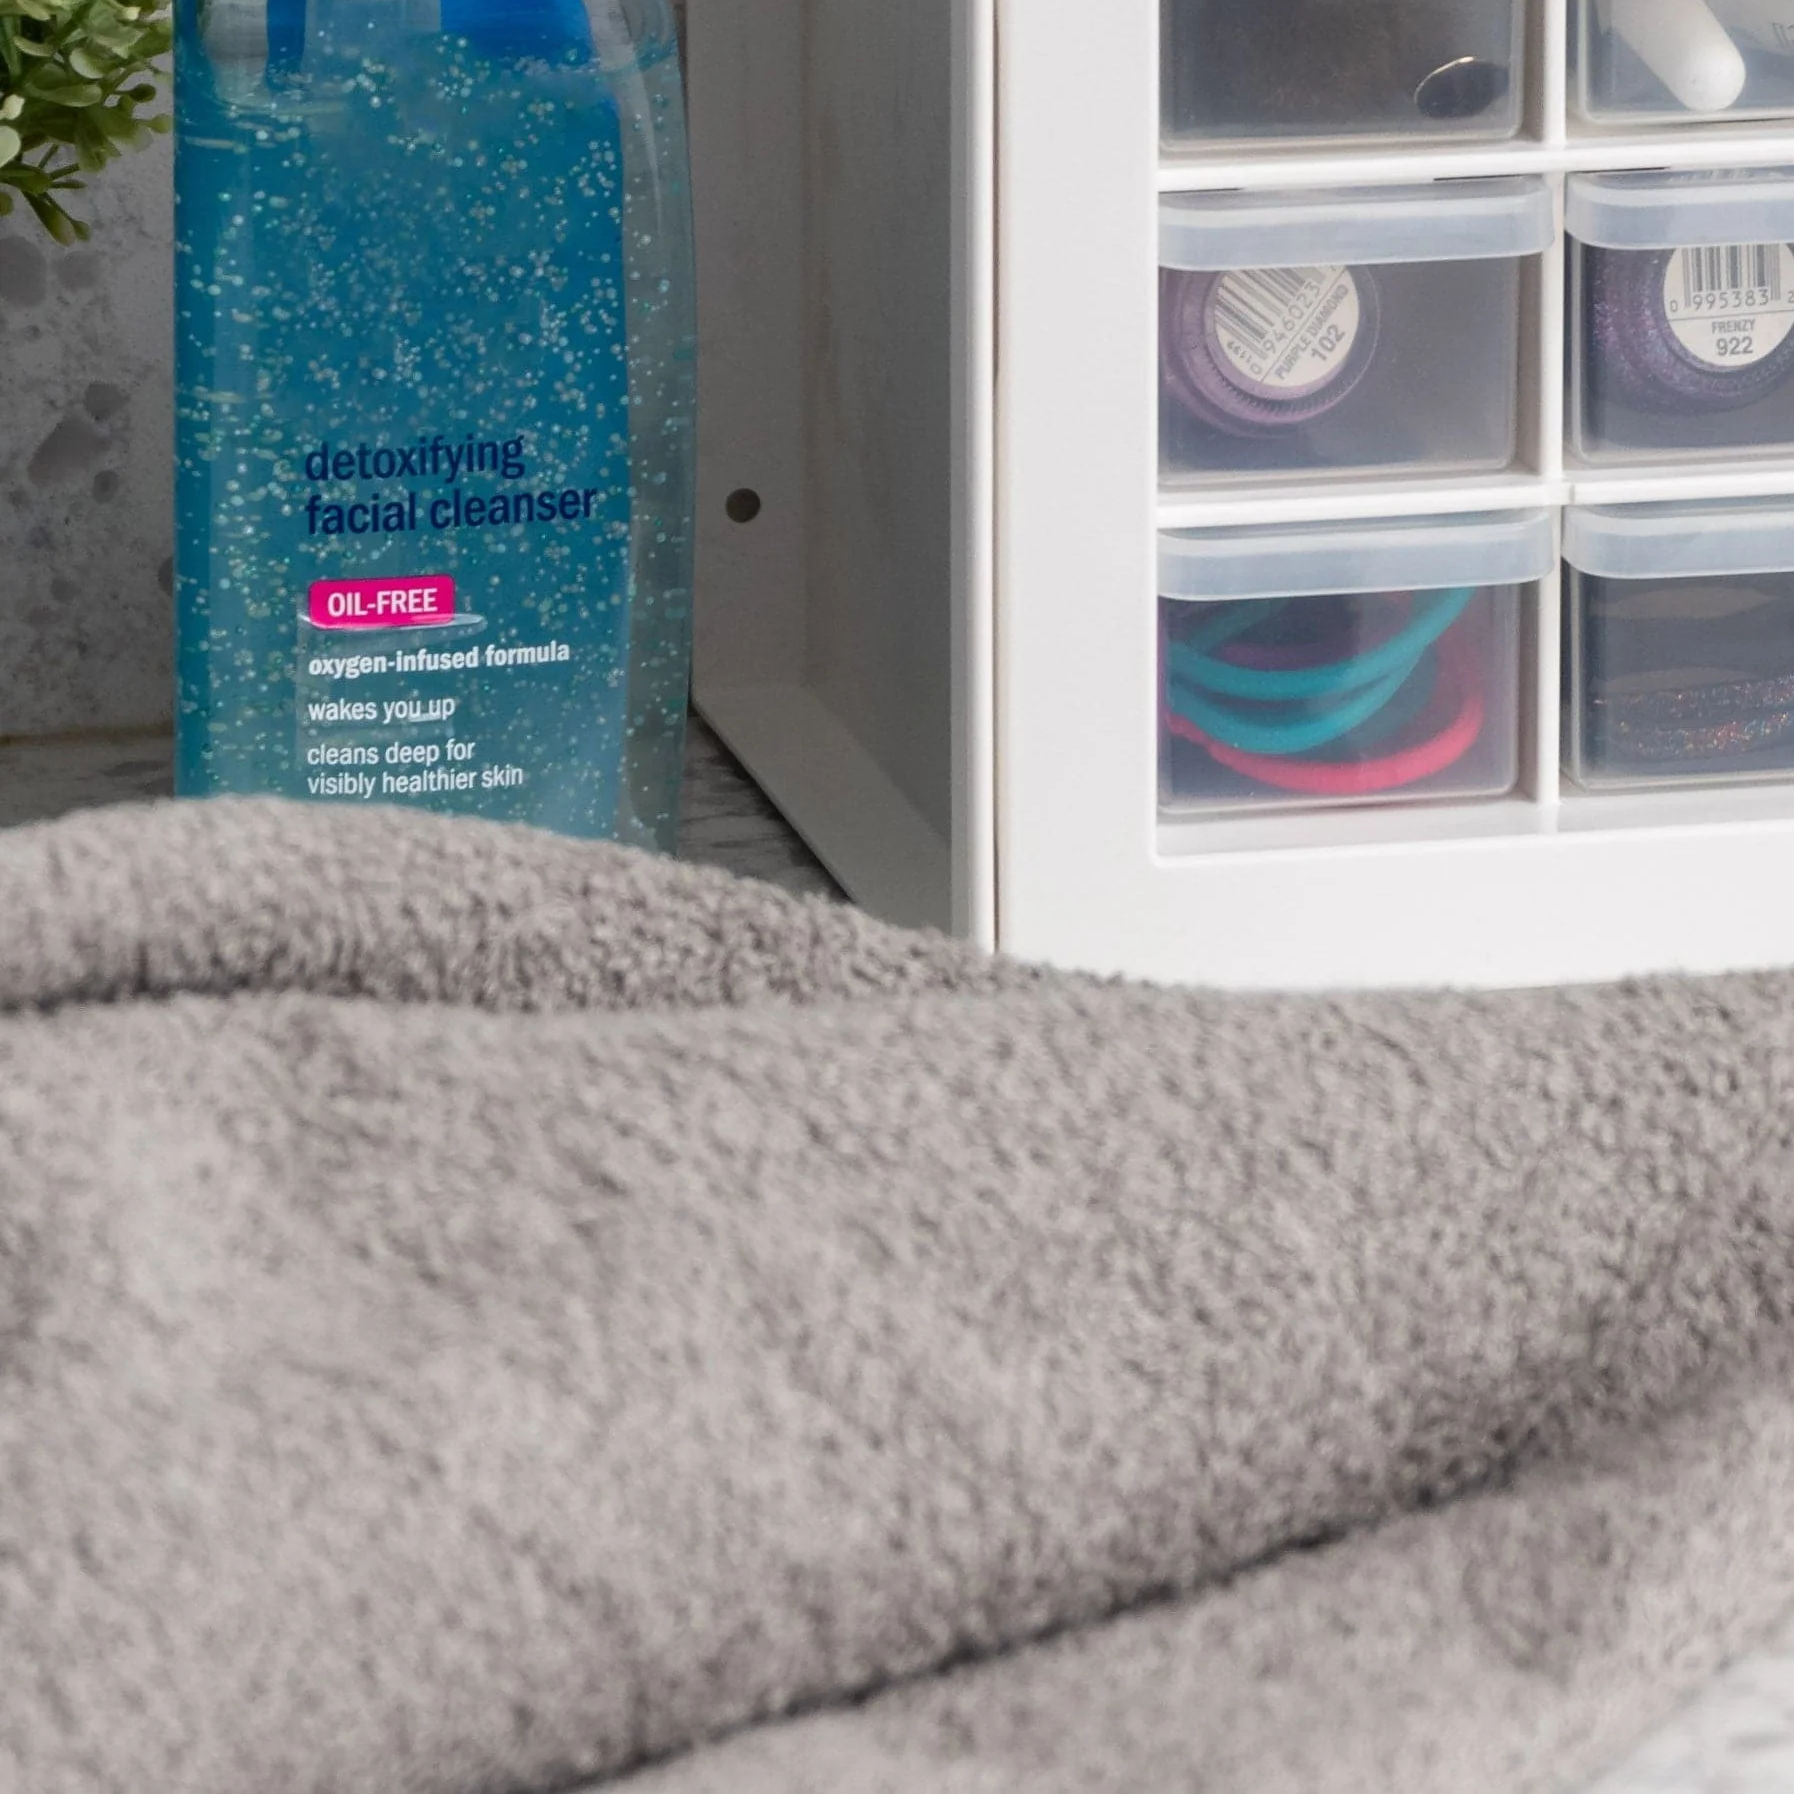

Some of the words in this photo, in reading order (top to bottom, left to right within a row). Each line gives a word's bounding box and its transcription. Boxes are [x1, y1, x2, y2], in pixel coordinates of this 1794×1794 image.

[1691, 288, 1770, 311] 995383
[1310, 324, 1346, 362] 102
[1711, 318, 1756, 335] FRENZY
[1274, 336, 1312, 380] PURPLE
[1716, 336, 1754, 357] 922
[305, 433, 526, 484] detoxifying
[305, 491, 417, 535] facial
[429, 486, 599, 529] cleanser
[327, 587, 438, 618] OIL-FREE
[308, 647, 480, 680] oxygen-infused
[485, 639, 571, 668] formula
[307, 698, 378, 722] wakes
[382, 699, 422, 724] you
[427, 697, 456, 721] up
[306, 741, 379, 766] cleans
[384, 740, 440, 767] deep
[445, 738, 476, 761] for
[306, 772, 377, 799] visibly
[382, 767, 477, 795] healthier
[480, 764, 524, 790] skin
